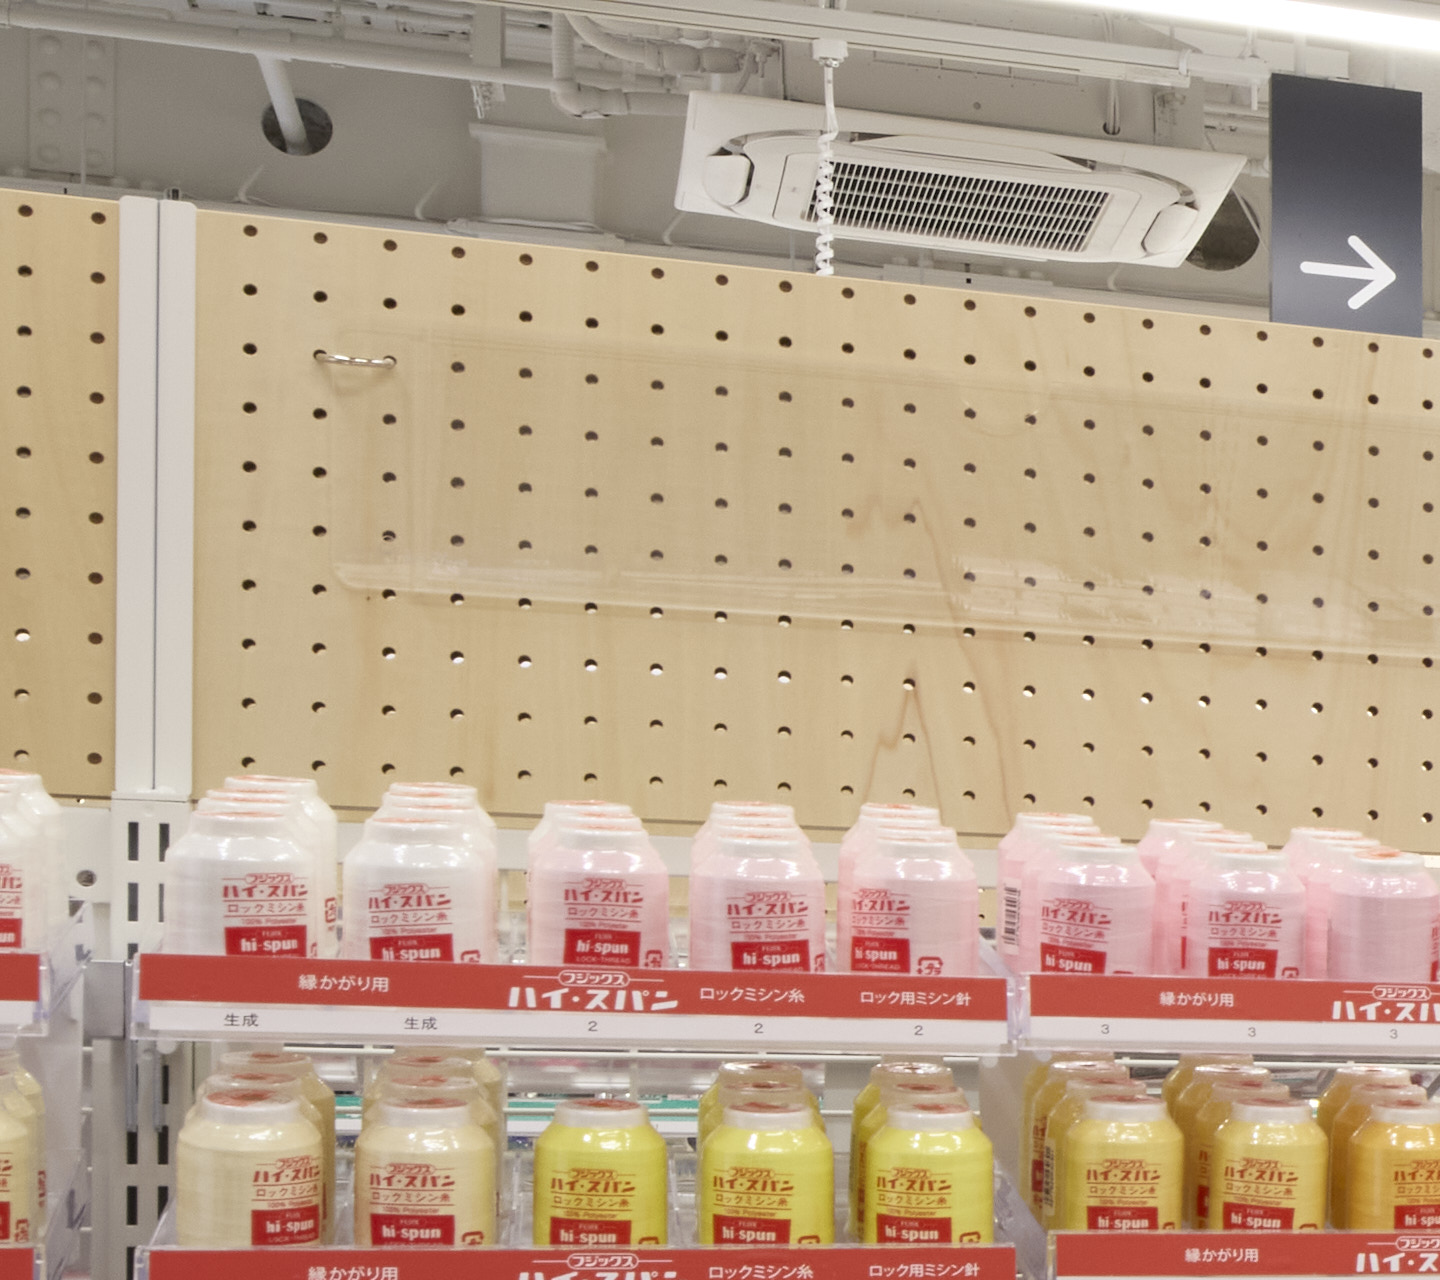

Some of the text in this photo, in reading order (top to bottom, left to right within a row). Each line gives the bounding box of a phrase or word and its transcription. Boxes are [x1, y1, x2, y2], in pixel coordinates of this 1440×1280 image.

[299, 975, 971, 1010] 縁かがり用 ハイ・スパン ロックミシン糸 ロック用ミシン針
[225, 1014, 597, 1032] 生成 生成 2
